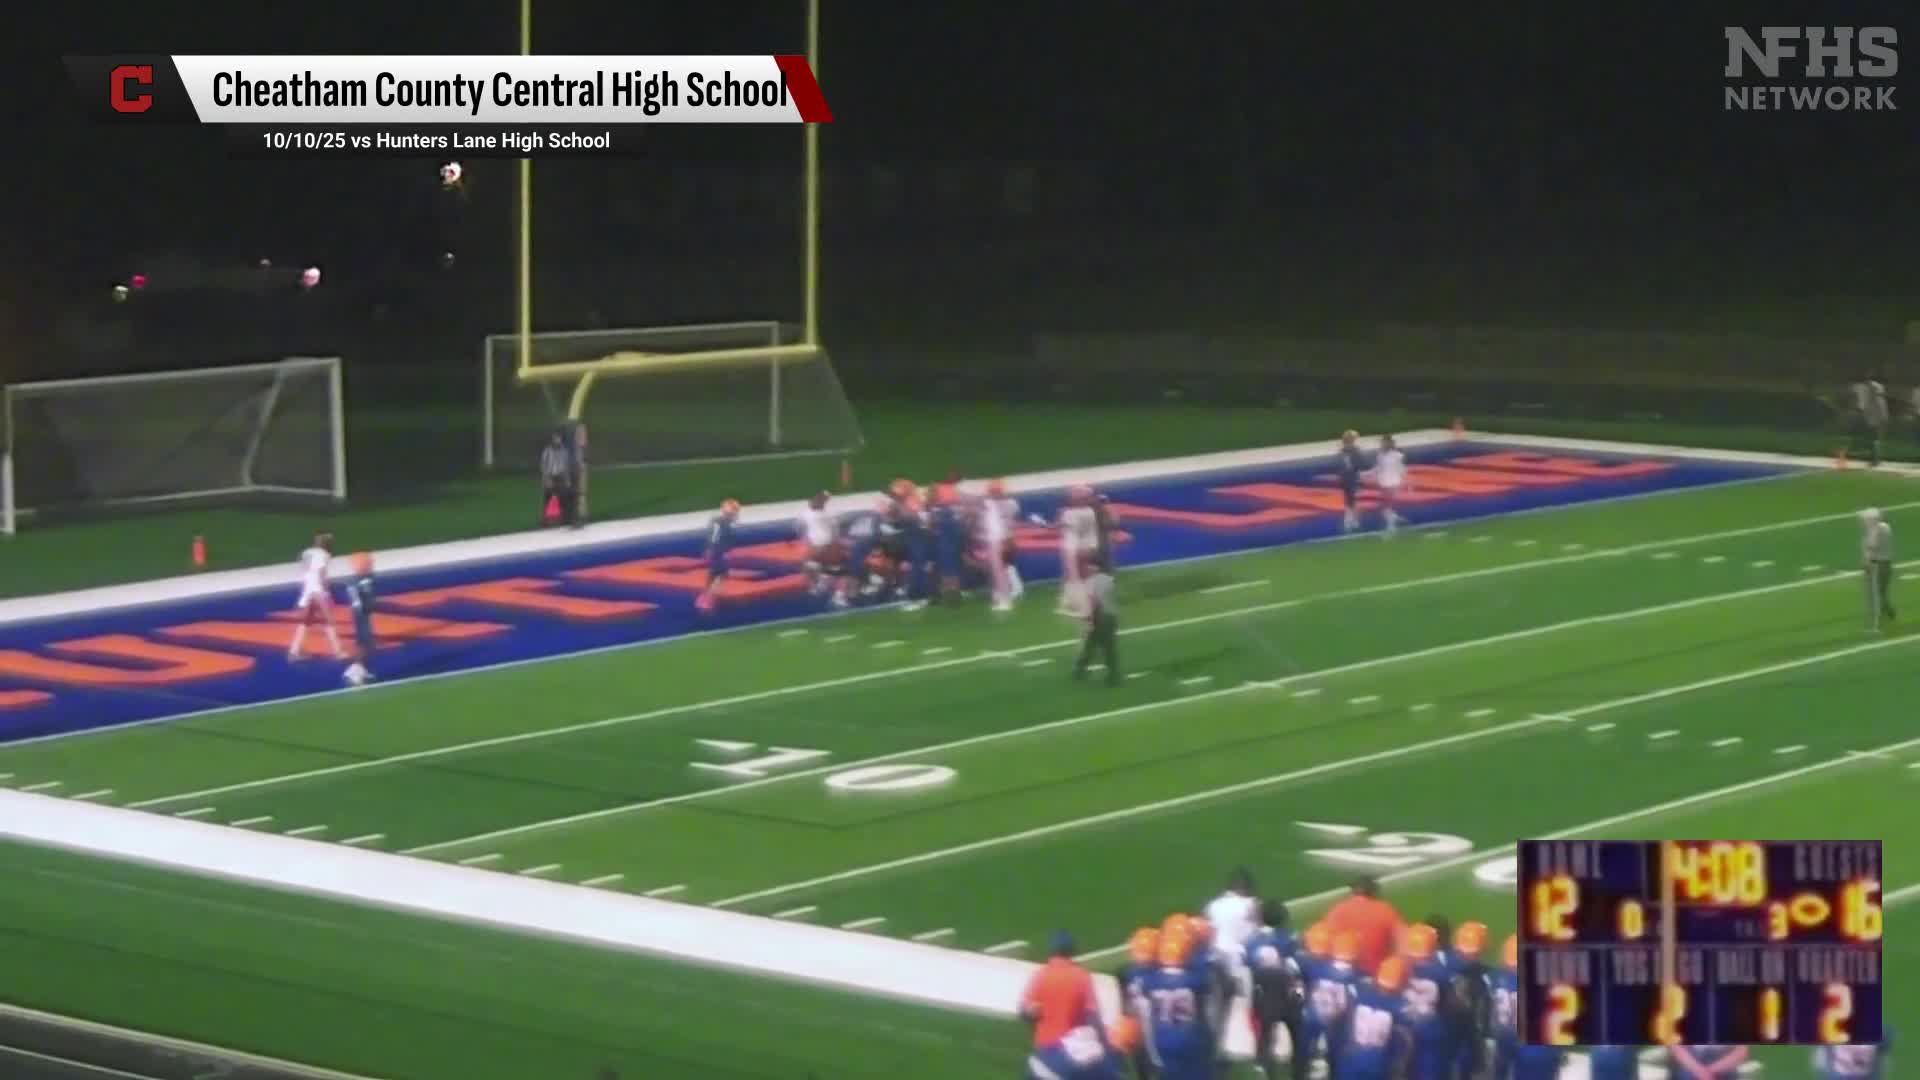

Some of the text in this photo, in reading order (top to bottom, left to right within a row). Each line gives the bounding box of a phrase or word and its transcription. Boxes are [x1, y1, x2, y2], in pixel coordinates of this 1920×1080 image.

[1533, 874, 1579, 940] 12
[1547, 983, 1579, 1045] 2
[1761, 986, 1781, 1041] 1
[1821, 983, 1853, 1044] 2
